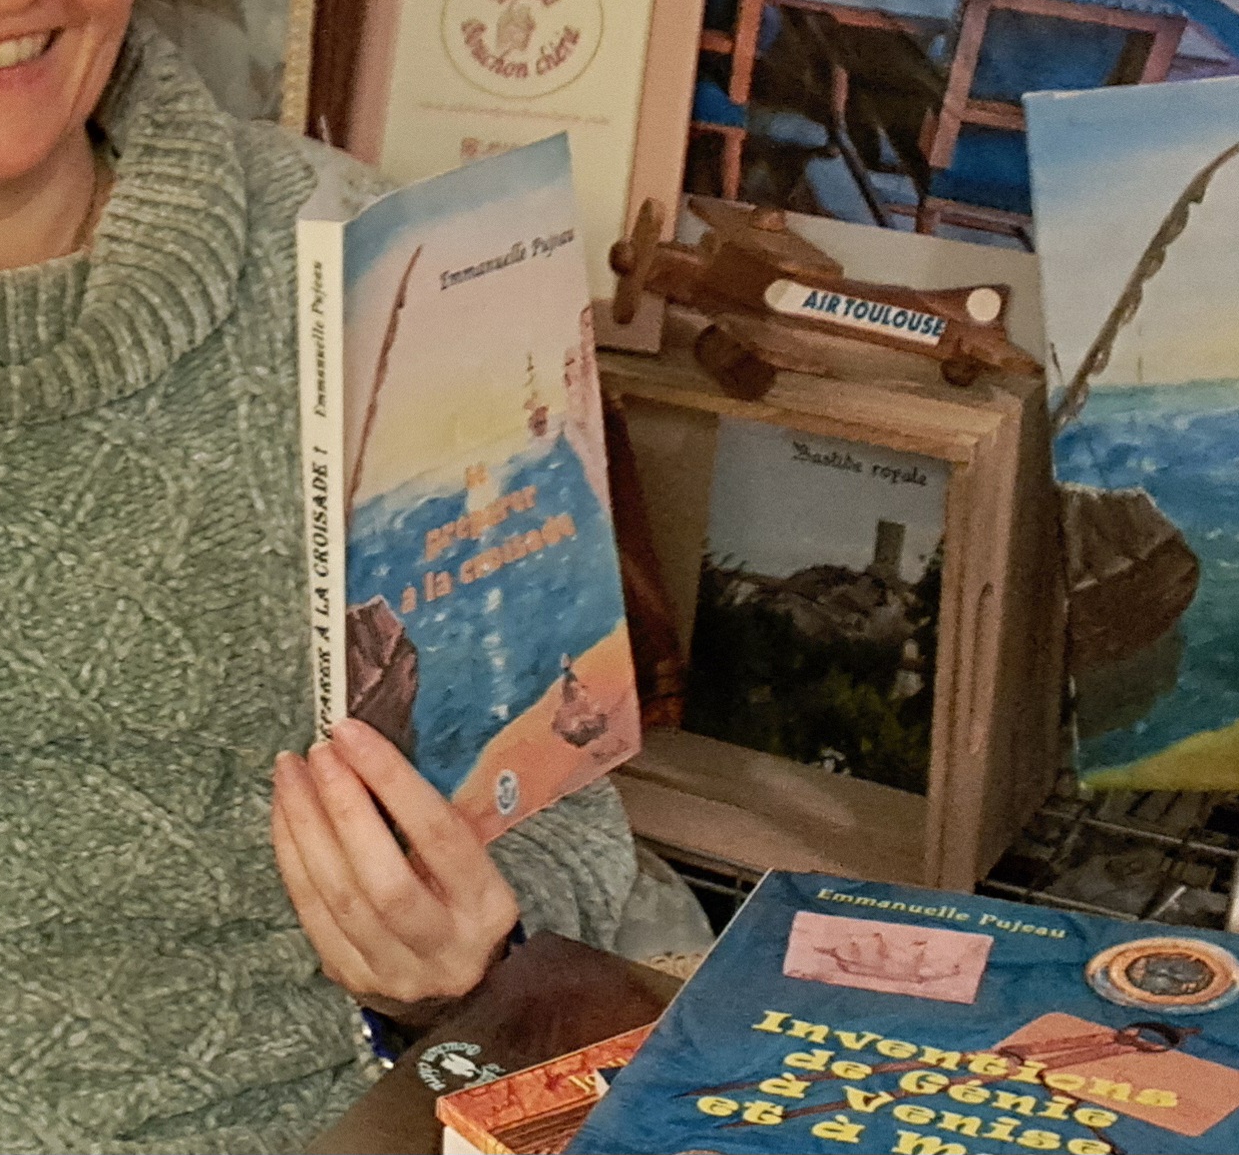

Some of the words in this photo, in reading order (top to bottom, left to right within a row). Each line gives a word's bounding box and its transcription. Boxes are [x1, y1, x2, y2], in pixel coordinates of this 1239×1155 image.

[802, 291, 840, 315] AIR
[845, 299, 947, 337] TOULOUSE
[312, 461, 329, 579] CROISADE
[816, 888, 970, 922] Emmanuelle
[978, 912, 1067, 940] Pujeau
[752, 1009, 1178, 1108] Inventions
[784, 1048, 872, 1080] de
[900, 1070, 1118, 1129] Génie
[697, 1094, 784, 1126] et
[811, 1114, 865, 1144] à
[759, 1073, 811, 1099] à
[844, 1085, 1113, 1155] Venise
